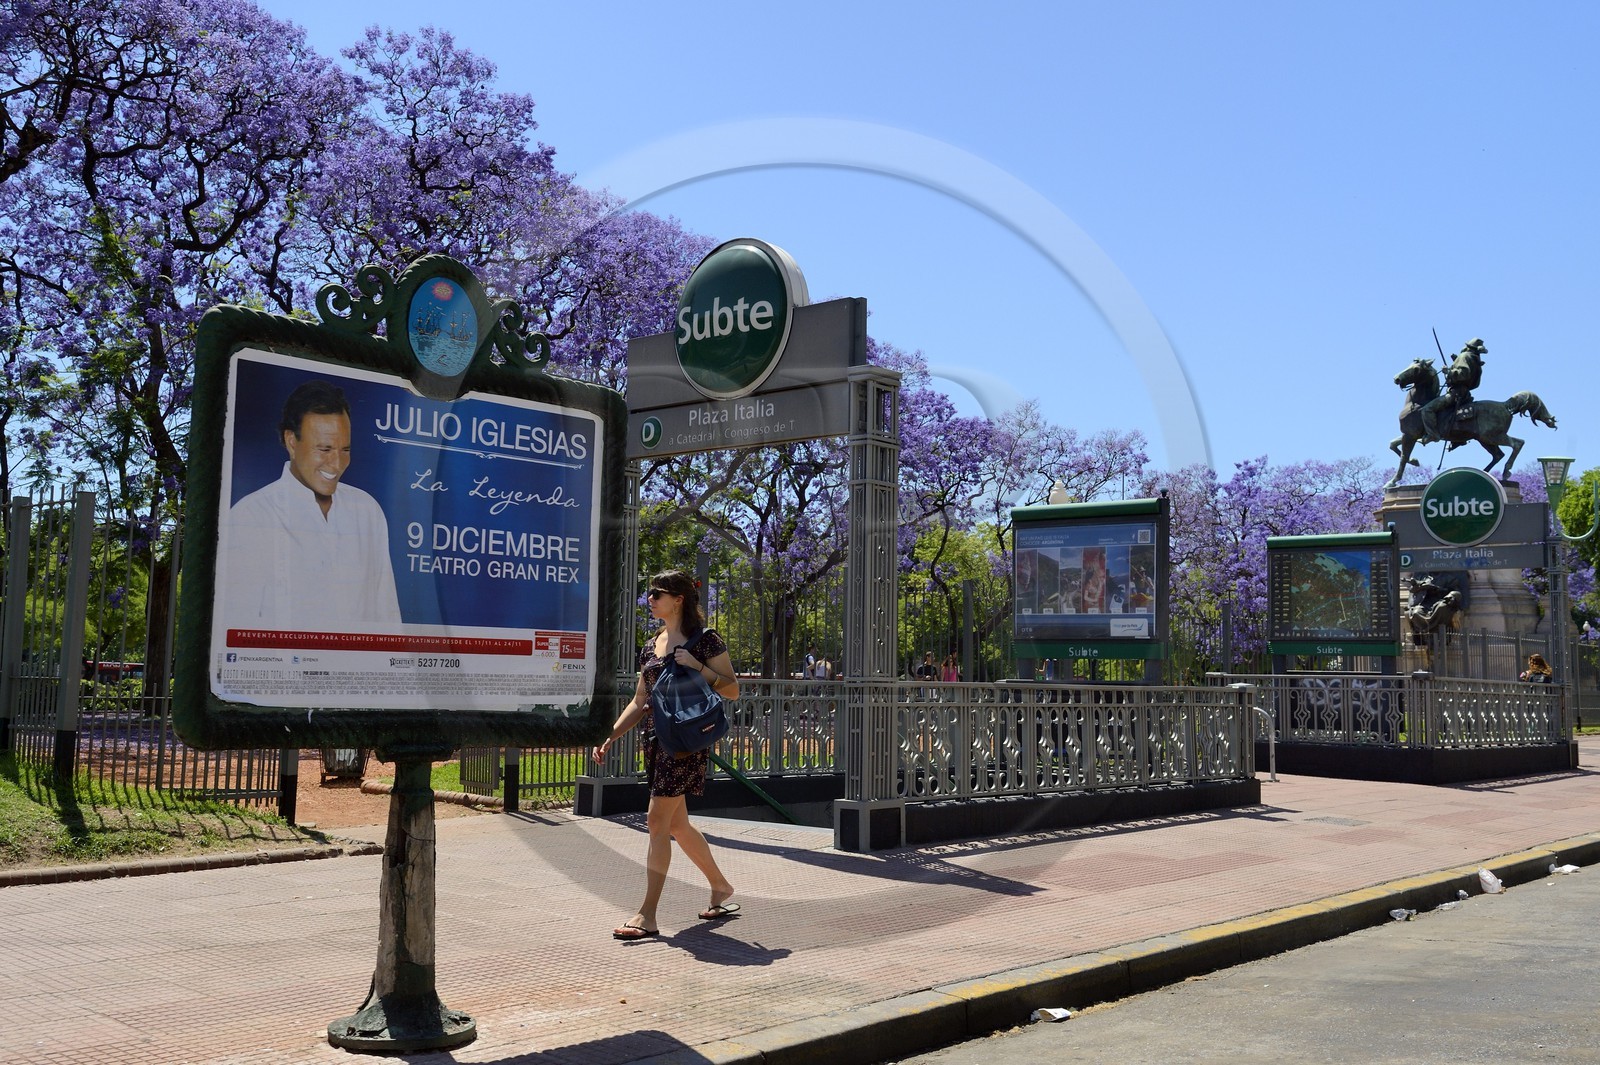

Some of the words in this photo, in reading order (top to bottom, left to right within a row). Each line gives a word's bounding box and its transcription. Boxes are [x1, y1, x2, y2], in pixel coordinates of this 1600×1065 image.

[678, 296, 774, 345] Subte
[688, 408, 729, 427] Plaza
[734, 399, 775, 421] Italia
[375, 402, 462, 441] JULIO
[471, 417, 587, 460] IGLESIAS
[642, 422, 655, 442] D
[676, 430, 715, 445] Catedral
[724, 425, 770, 441] Congreso
[773, 421, 786, 433] de
[410, 468, 449, 492] La
[468, 475, 580, 515] Leyenda
[1426, 495, 1494, 518] Subte
[407, 521, 424, 549] 9
[432, 523, 580, 562] DICIEMBRE
[1401, 555, 1411, 566] D
[1432, 550, 1462, 560] Plaza
[1465, 548, 1494, 558] Italia
[406, 553, 481, 577] TEATRO
[487, 560, 539, 581] GRAN
[545, 566, 580, 584] REX
[237, 631, 277, 639] PREVENTA
[1068, 646, 1099, 657] Subte
[1316, 646, 1343, 654] Subte
[417, 658, 438, 668] 5237
[440, 658, 460, 668] 7200
